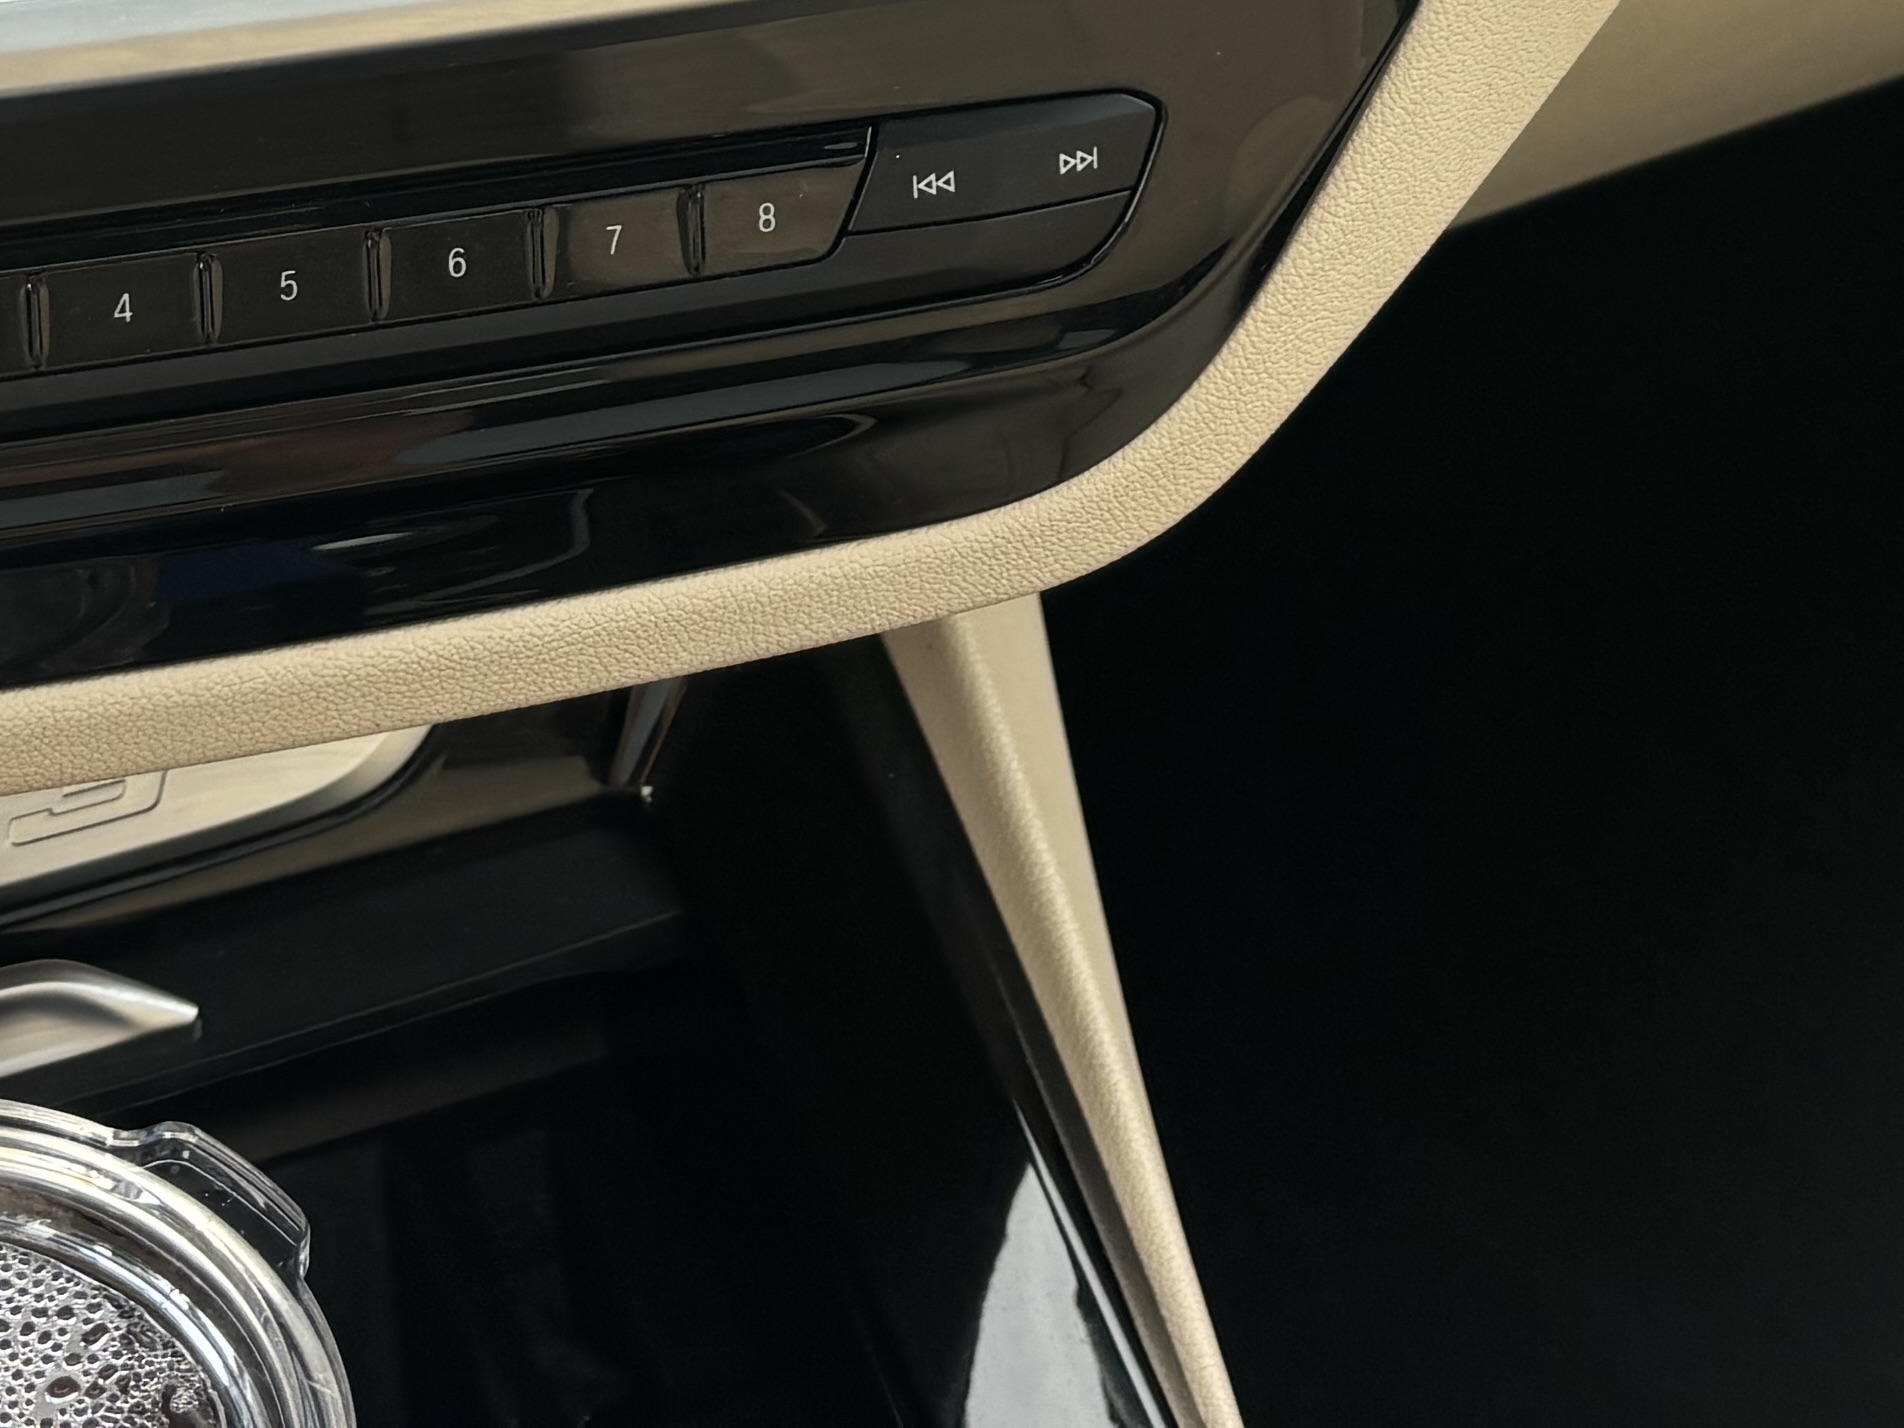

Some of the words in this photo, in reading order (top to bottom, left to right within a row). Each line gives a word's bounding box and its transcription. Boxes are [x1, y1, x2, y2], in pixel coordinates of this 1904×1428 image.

[758, 202, 776, 233] 8
[605, 224, 622, 255] 7
[448, 247, 467, 278] 6
[280, 270, 298, 301] 5
[113, 292, 133, 323] 4
